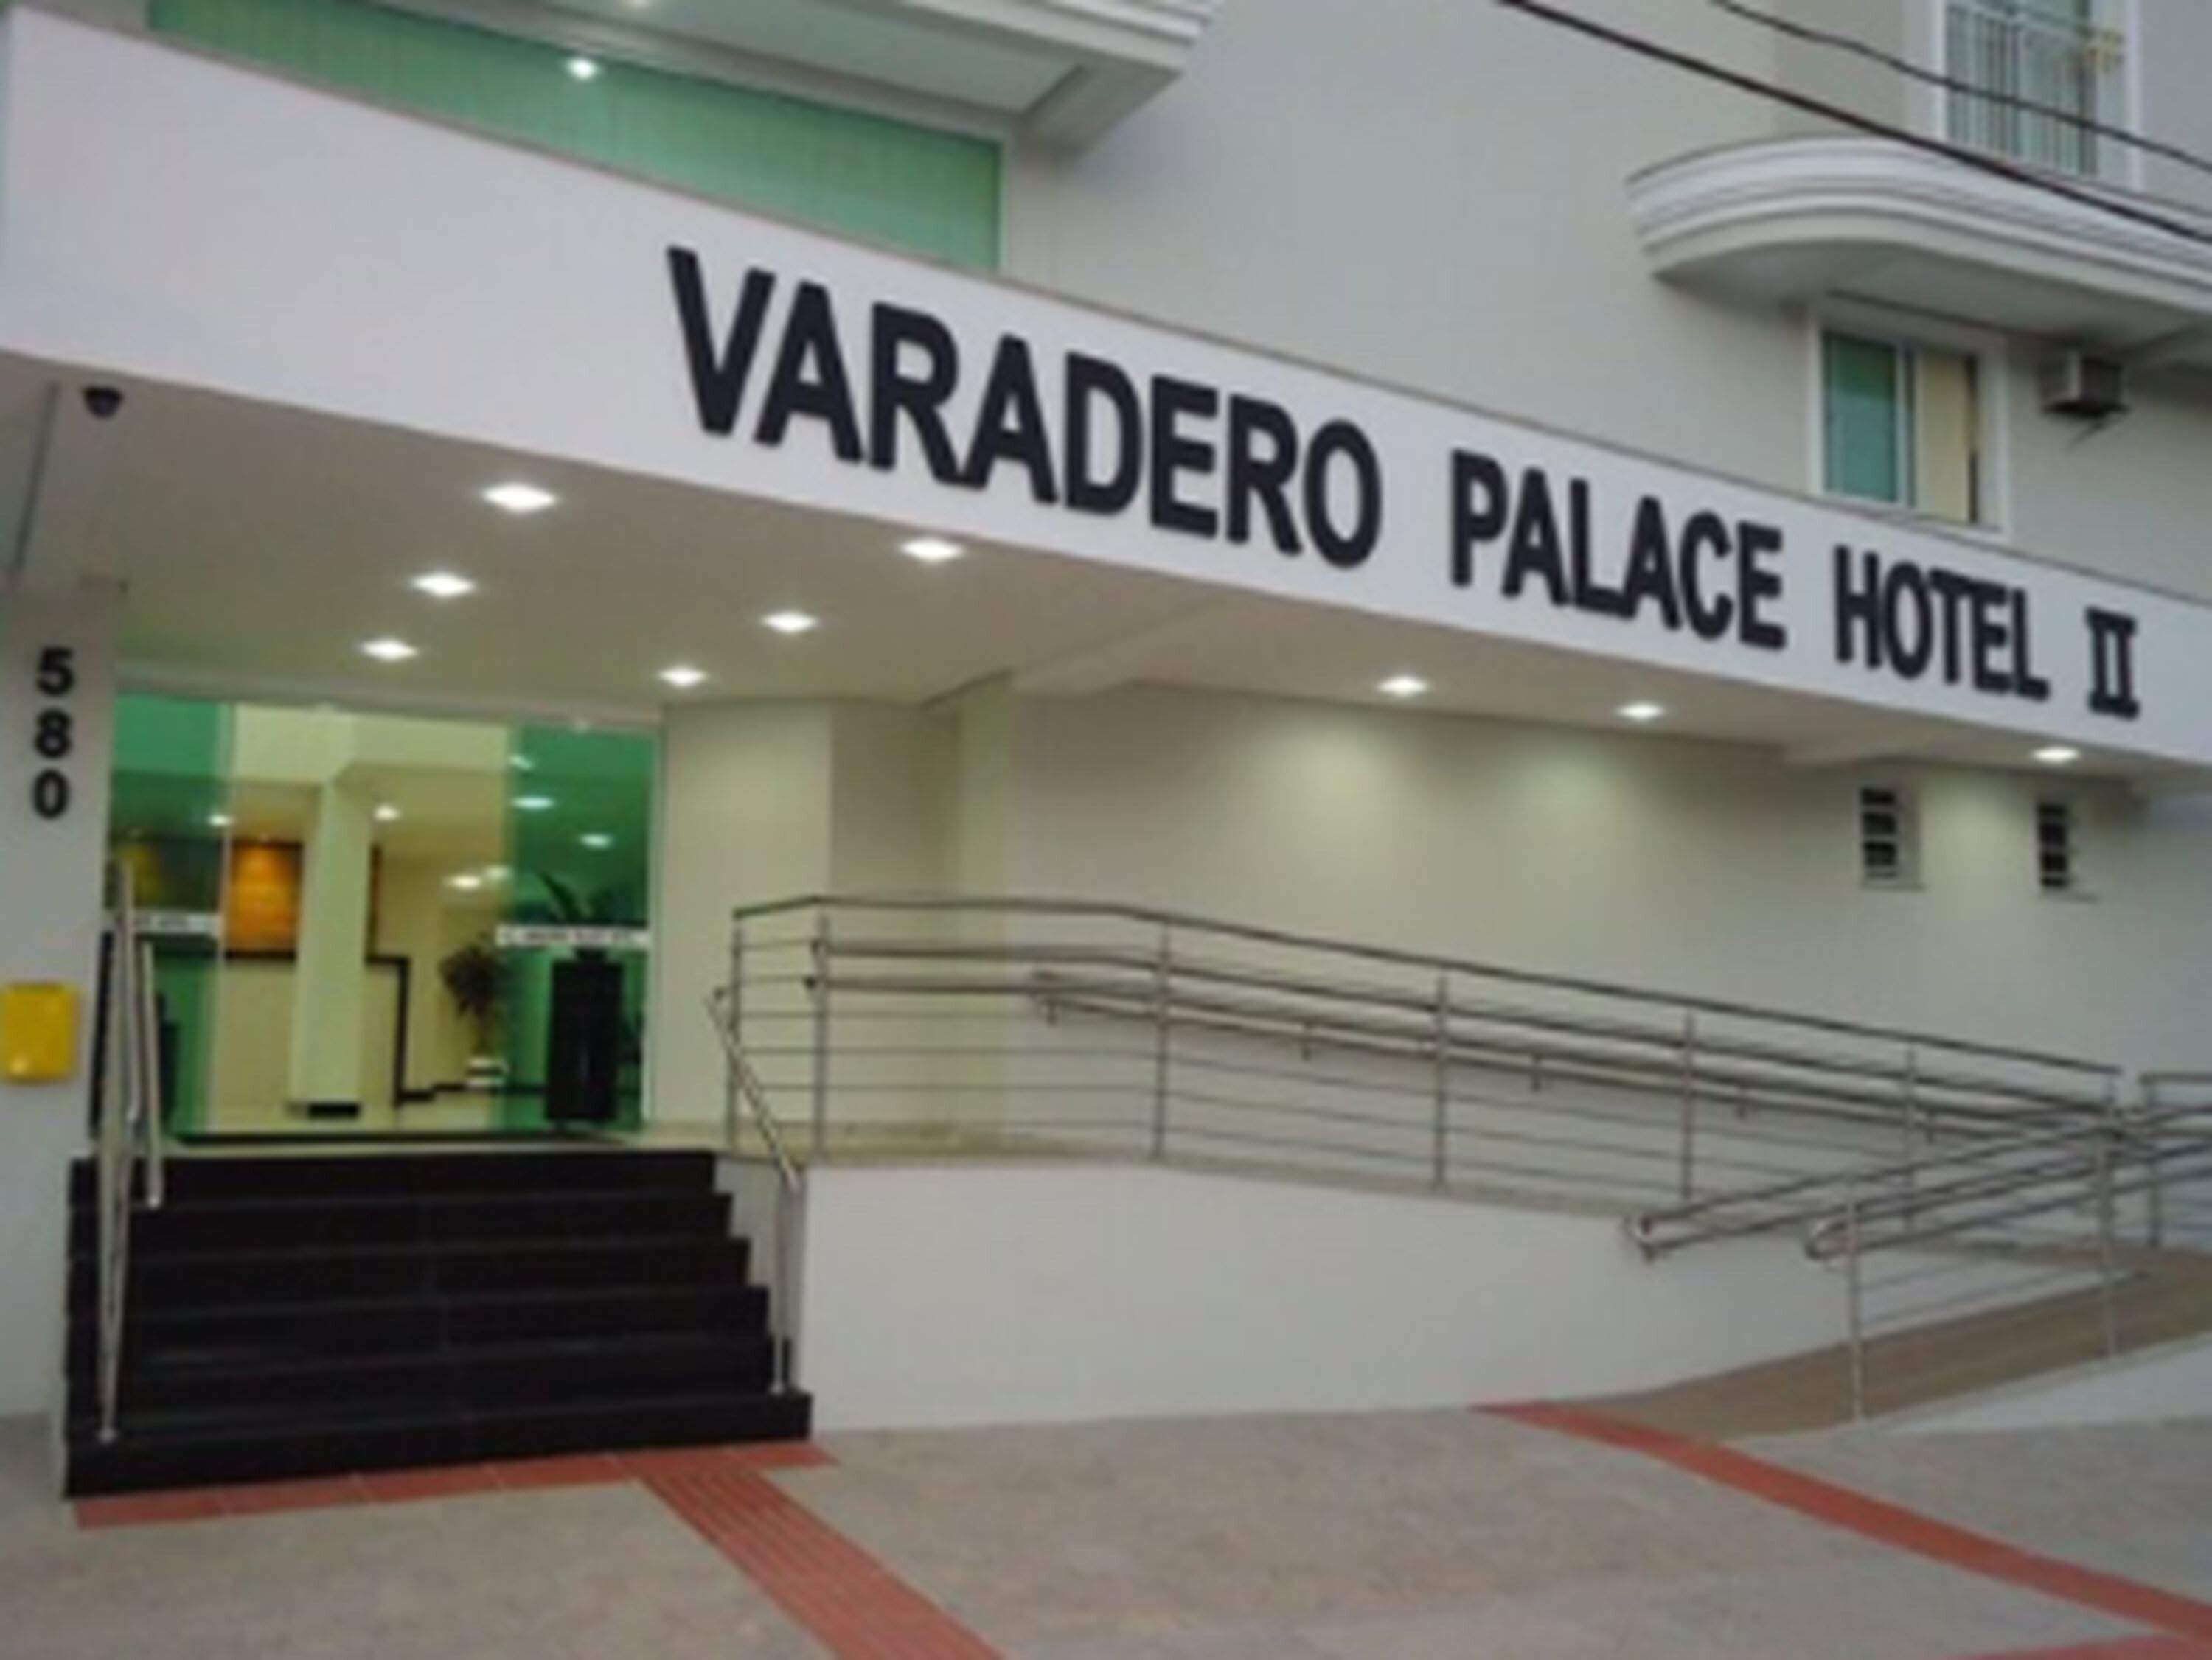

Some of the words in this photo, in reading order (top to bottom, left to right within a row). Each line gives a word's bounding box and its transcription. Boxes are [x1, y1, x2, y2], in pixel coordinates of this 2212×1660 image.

[668, 248, 1381, 569] VARADERO
[1452, 450, 1786, 649] PALACE
[1834, 546, 2050, 700] HOTEL
[2086, 607, 2140, 720] II
